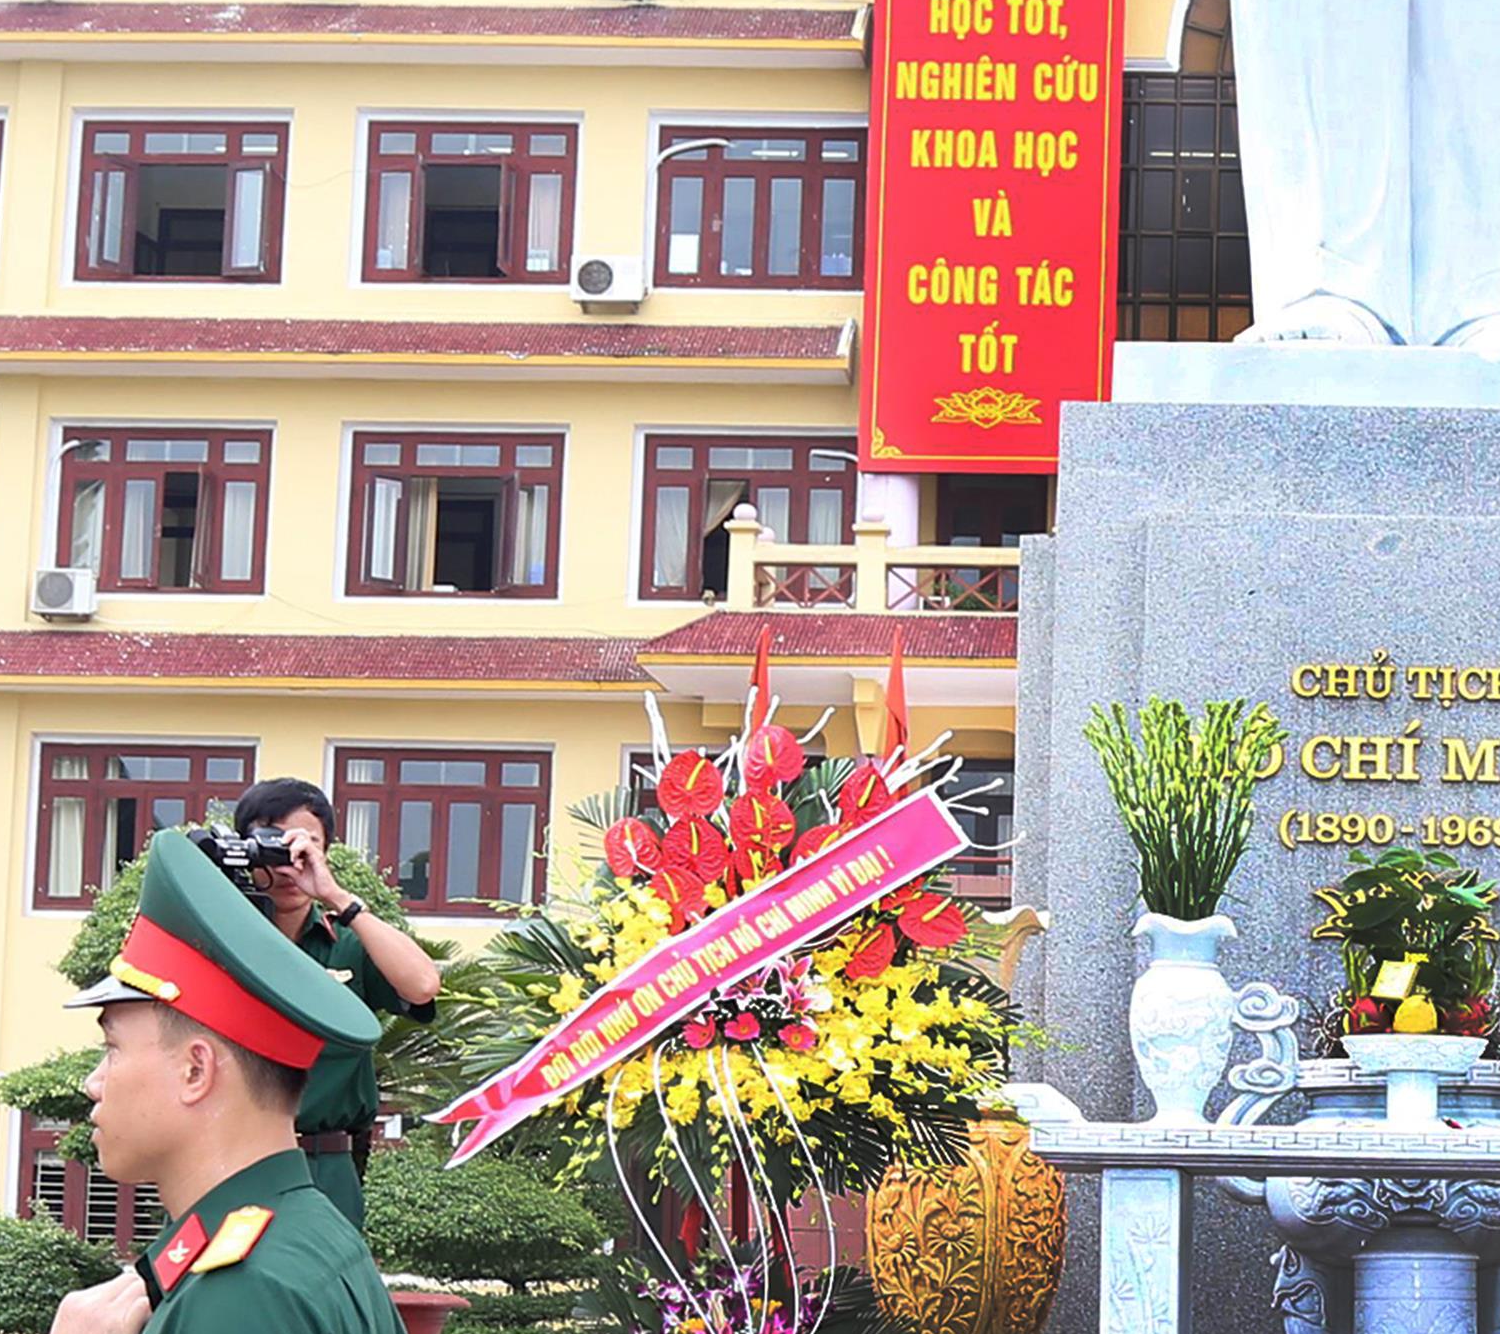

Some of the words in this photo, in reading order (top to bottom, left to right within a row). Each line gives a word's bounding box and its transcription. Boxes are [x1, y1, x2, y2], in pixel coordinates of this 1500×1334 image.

[895, 55, 1018, 102] NGHIÊN
[1032, 54, 1099, 102] CỨU
[910, 129, 999, 169] KHOA
[1012, 130, 1078, 177] HỌC
[972, 189, 1012, 237] VÀ
[907, 257, 999, 305] CÔNG
[1015, 259, 1075, 307] TÁC
[958, 320, 1019, 374] TỐT
[1291, 648, 1396, 699] CHỦ
[1301, 718, 1422, 782] CHÍ
[1278, 808, 1395, 851] (1890
[569, 1028, 606, 1068] ĐỜI
[597, 998, 639, 1046] NHỚ
[755, 901, 794, 940] CHÍ
[784, 879, 838, 923] MINH
